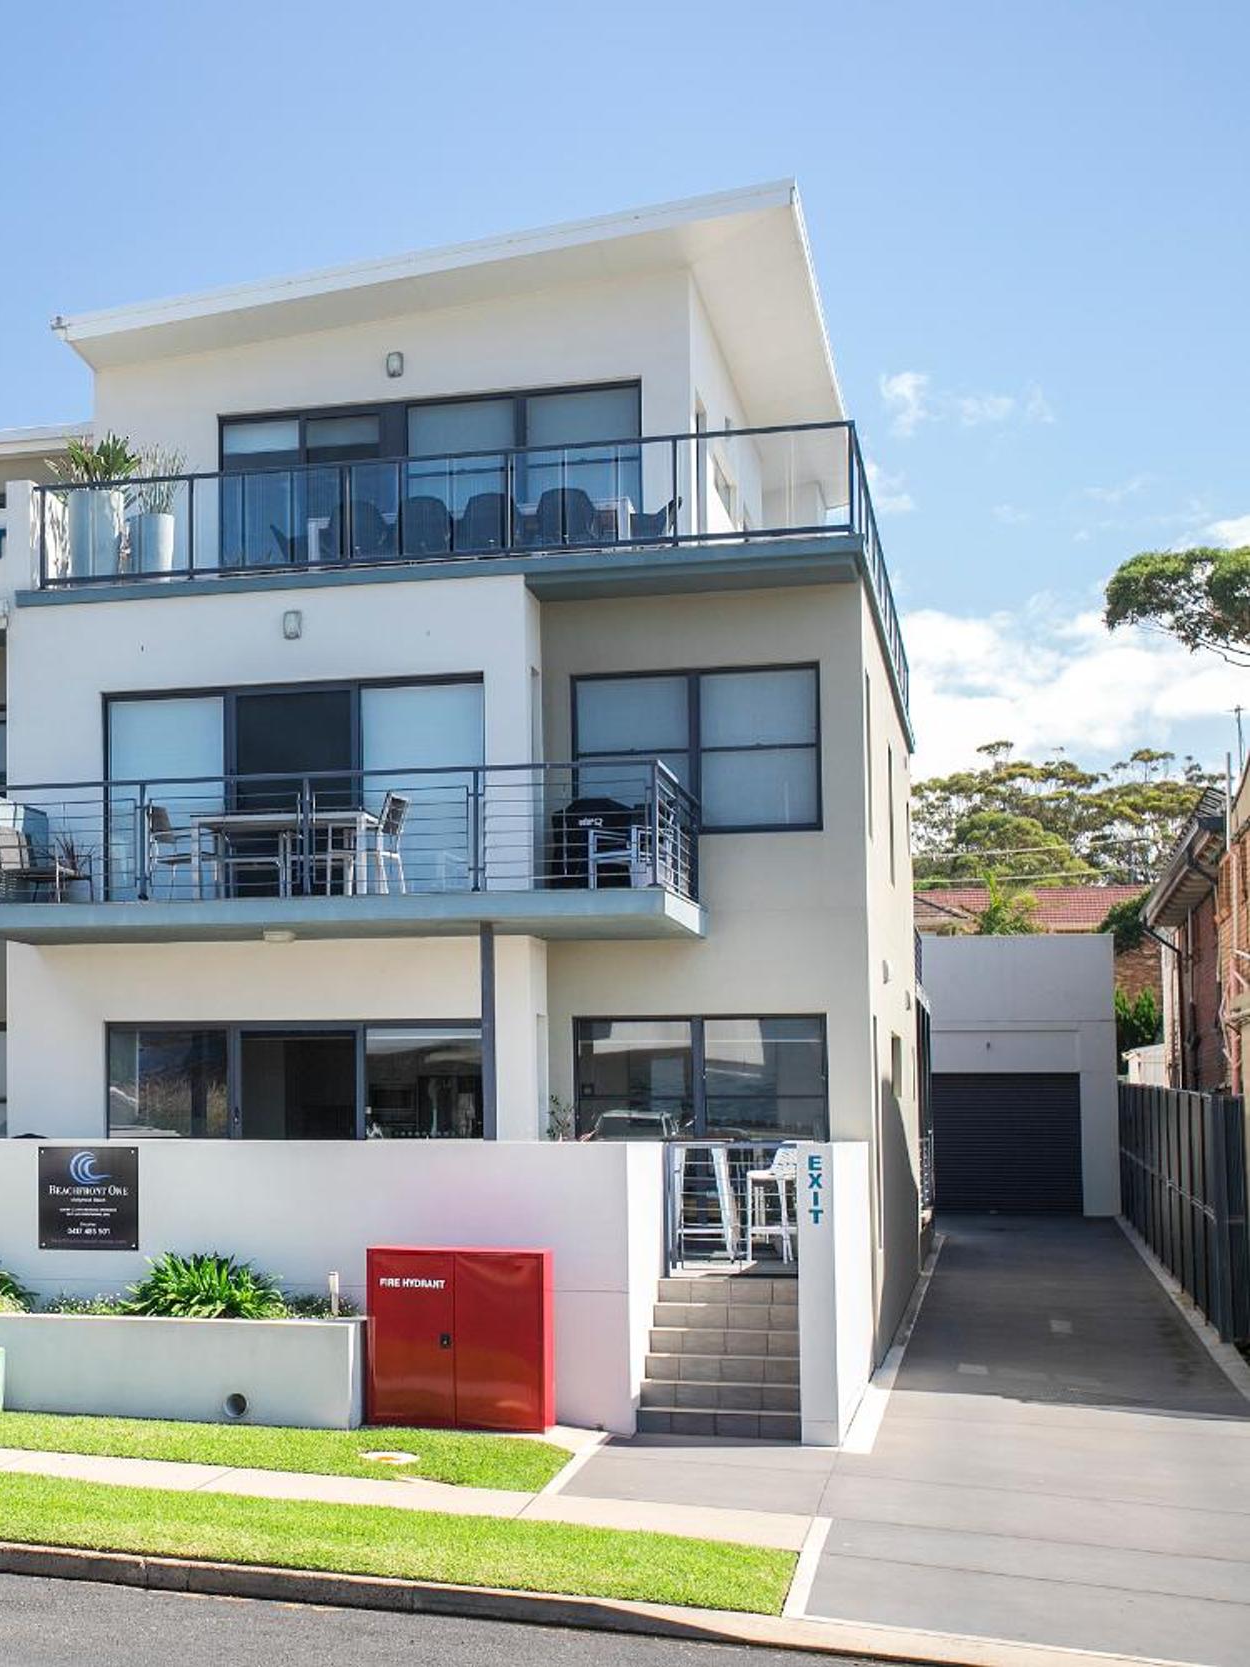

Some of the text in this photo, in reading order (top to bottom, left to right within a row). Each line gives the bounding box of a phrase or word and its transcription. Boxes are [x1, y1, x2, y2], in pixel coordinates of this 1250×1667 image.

[49, 1185, 107, 1197] BEACHFRONT
[808, 1155, 824, 1224] EXIT
[379, 1278, 446, 1289] FIRE HYDRANT
